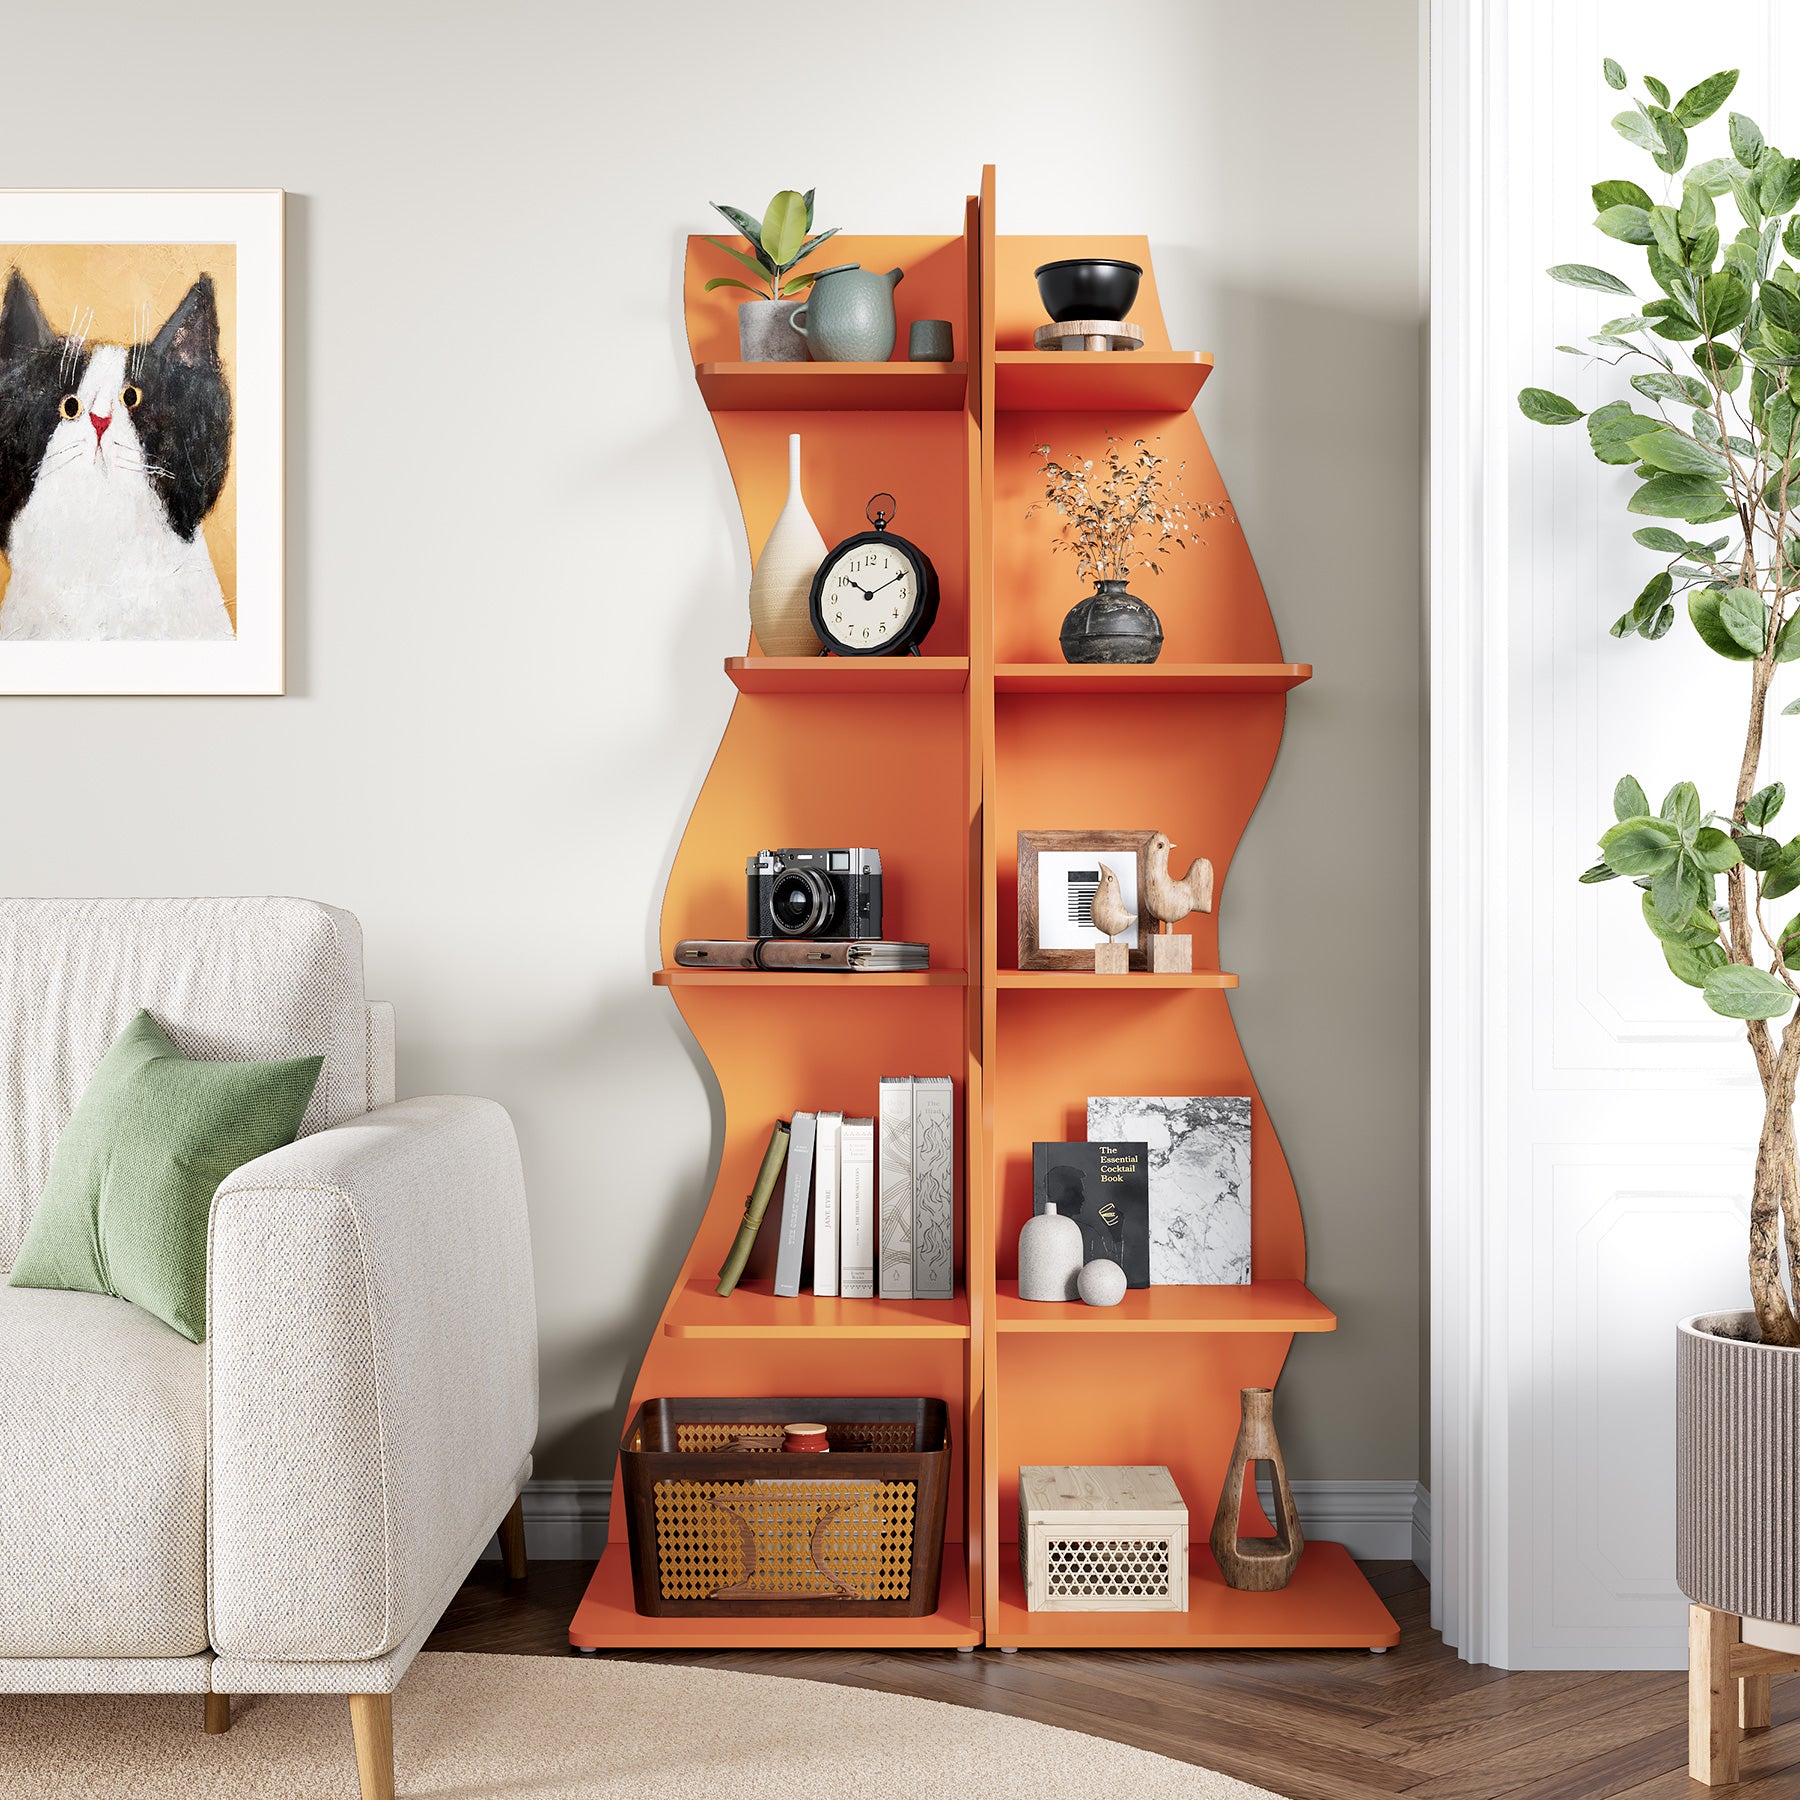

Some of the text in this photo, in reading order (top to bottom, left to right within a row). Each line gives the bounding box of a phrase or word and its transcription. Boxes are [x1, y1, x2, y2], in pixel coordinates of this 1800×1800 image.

[850, 561, 861, 572] 11
[865, 554, 877, 567] 12
[838, 574, 850, 587] 10
[830, 593, 838, 605] 9
[899, 587, 907, 599] 3
[835, 611, 843, 623] 8
[892, 607, 899, 619] 4
[848, 624, 854, 636] 7
[862, 627, 870, 639] 6
[878, 622, 886, 633] 5
[1099, 1146, 1118, 1154] The
[1100, 1155, 1139, 1164] Essential
[1100, 1164, 1136, 1173] Cocktail
[1100, 1174, 1124, 1183] Book
